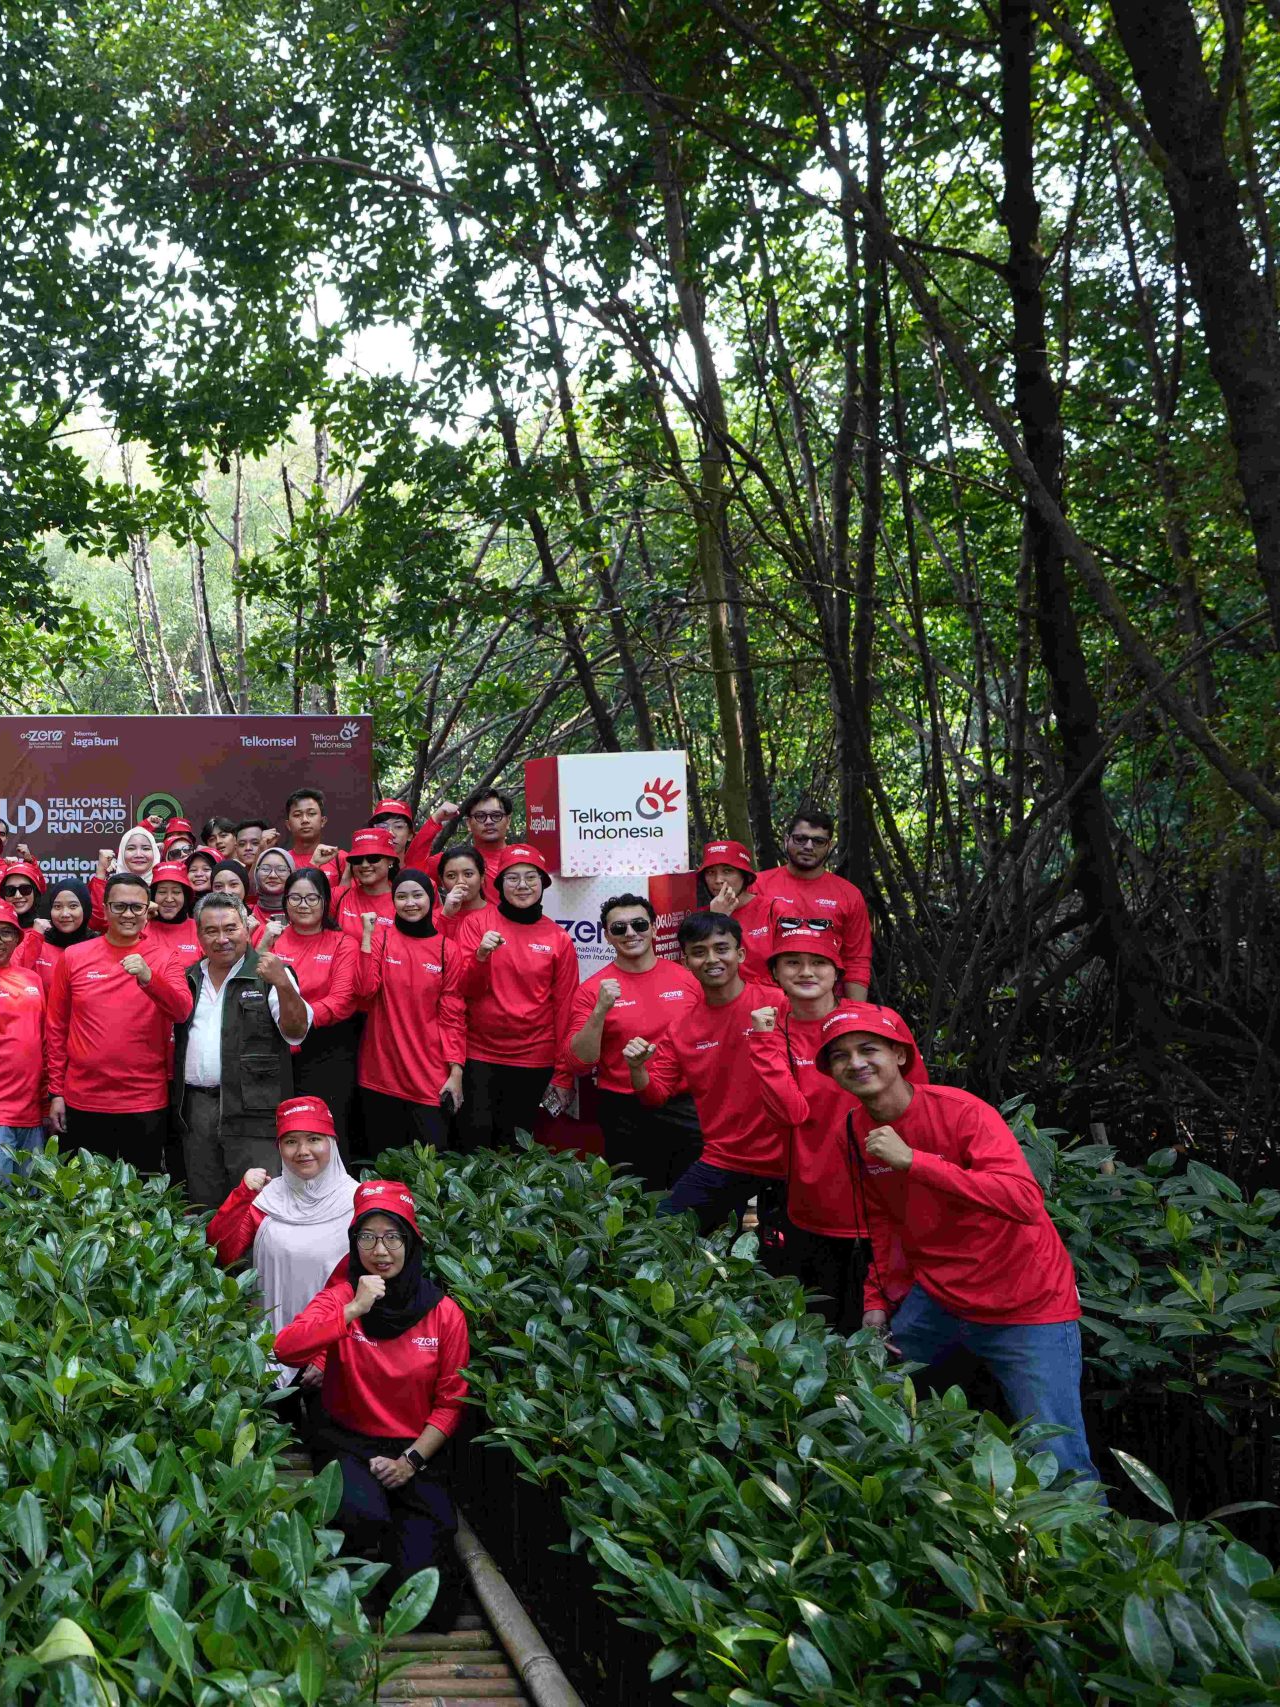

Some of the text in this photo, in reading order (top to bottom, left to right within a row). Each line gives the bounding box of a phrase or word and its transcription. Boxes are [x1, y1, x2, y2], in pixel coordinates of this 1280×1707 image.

[240, 736, 297, 748] Telkomsel
[314, 741, 352, 749] Indonesia
[48, 798, 126, 808] TELKOMSEL
[48, 809, 126, 821] DIGILAND
[569, 808, 632, 824] Telkom
[48, 822, 125, 834] RUN 2026
[578, 825, 664, 840] Indonesia
[575, 946, 603, 955] nability
